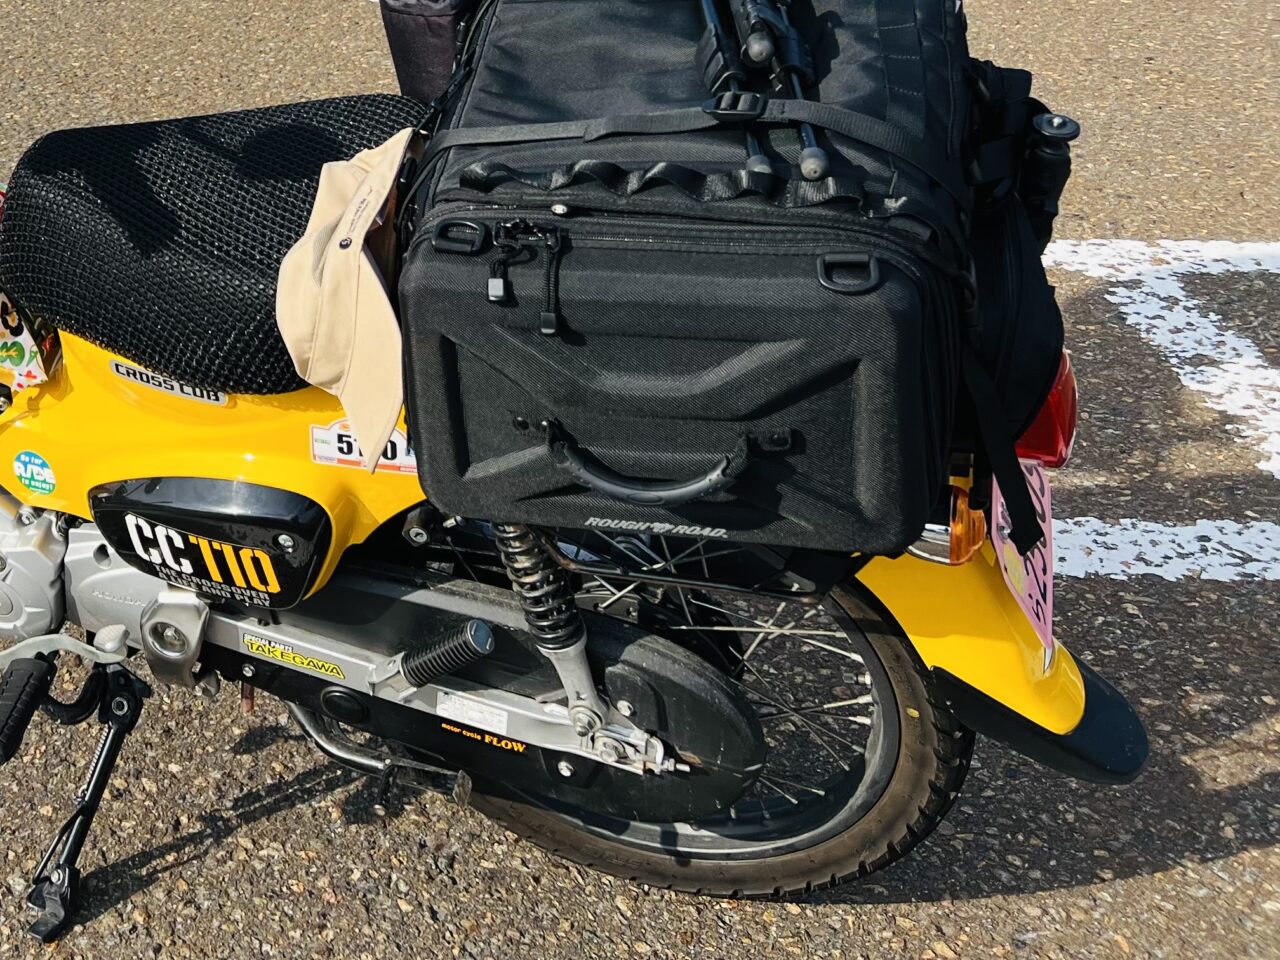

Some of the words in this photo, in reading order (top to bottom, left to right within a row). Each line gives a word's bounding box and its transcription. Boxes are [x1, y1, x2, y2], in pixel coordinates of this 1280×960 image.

[114, 363, 175, 391] CROSS
[13, 461, 56, 484] RIDE
[584, 517, 649, 530] ROUGH
[154, 563, 180, 577] THE
[181, 572, 270, 600] CROSSOVER
[201, 585, 232, 599] AND
[234, 593, 271, 607] PLAY
[270, 640, 293, 652] PARTS
[247, 641, 344, 678] TAKEGAWA
[441, 722, 461, 733] motor
[462, 729, 482, 741] cycle
[484, 734, 527, 753] FLOW
